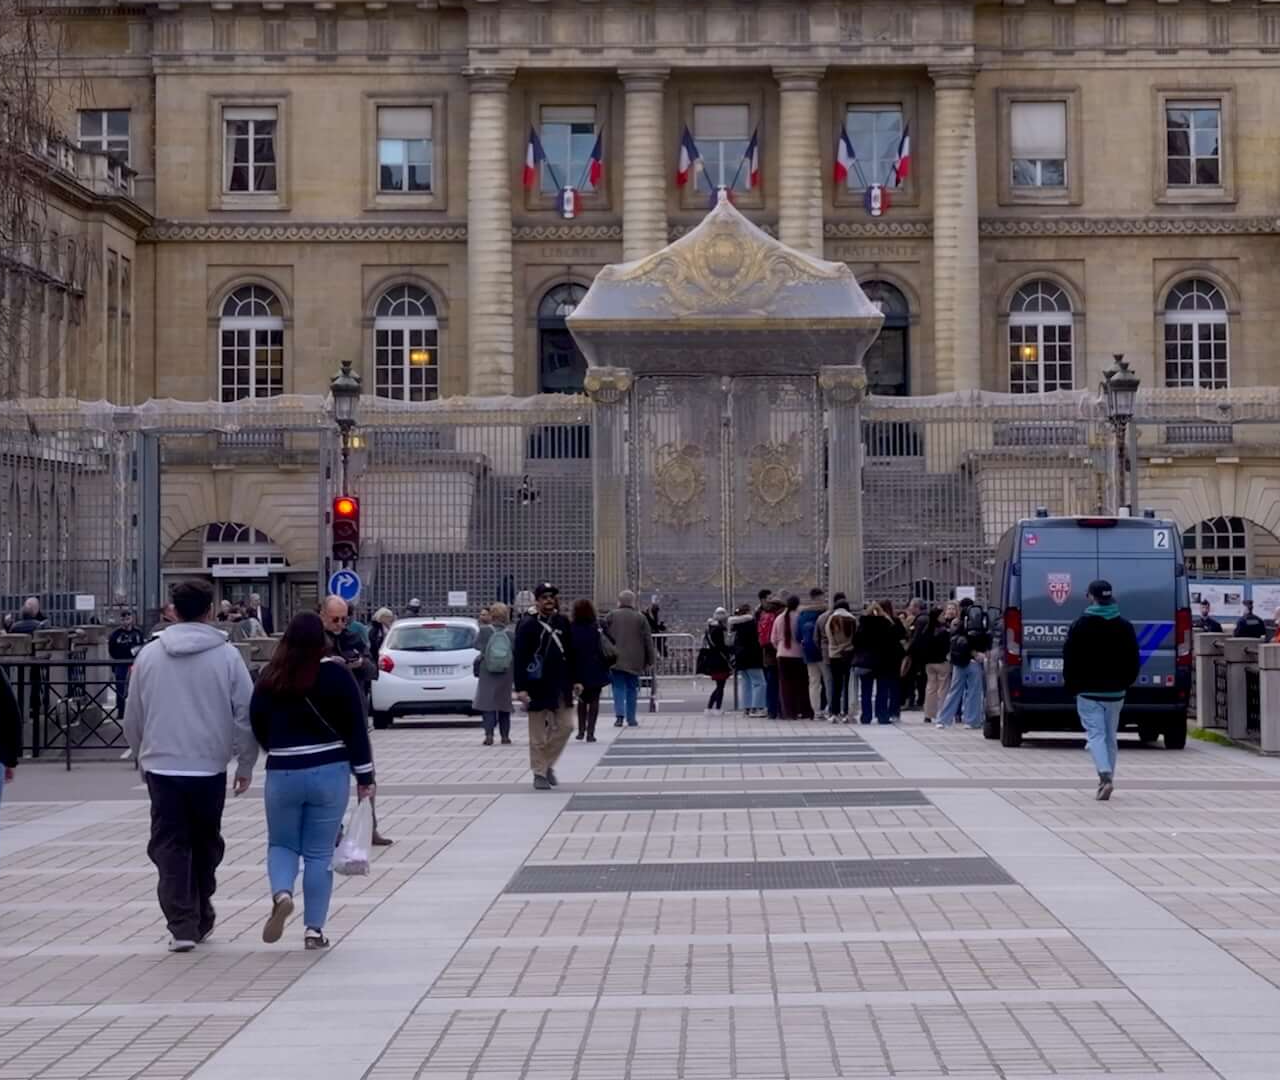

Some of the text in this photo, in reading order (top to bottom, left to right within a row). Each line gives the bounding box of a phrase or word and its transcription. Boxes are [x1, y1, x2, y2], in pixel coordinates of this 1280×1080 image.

[1157, 531, 1166, 548] 2
[1049, 584, 1069, 592] CRS
[1024, 625, 1069, 636] POLIC
